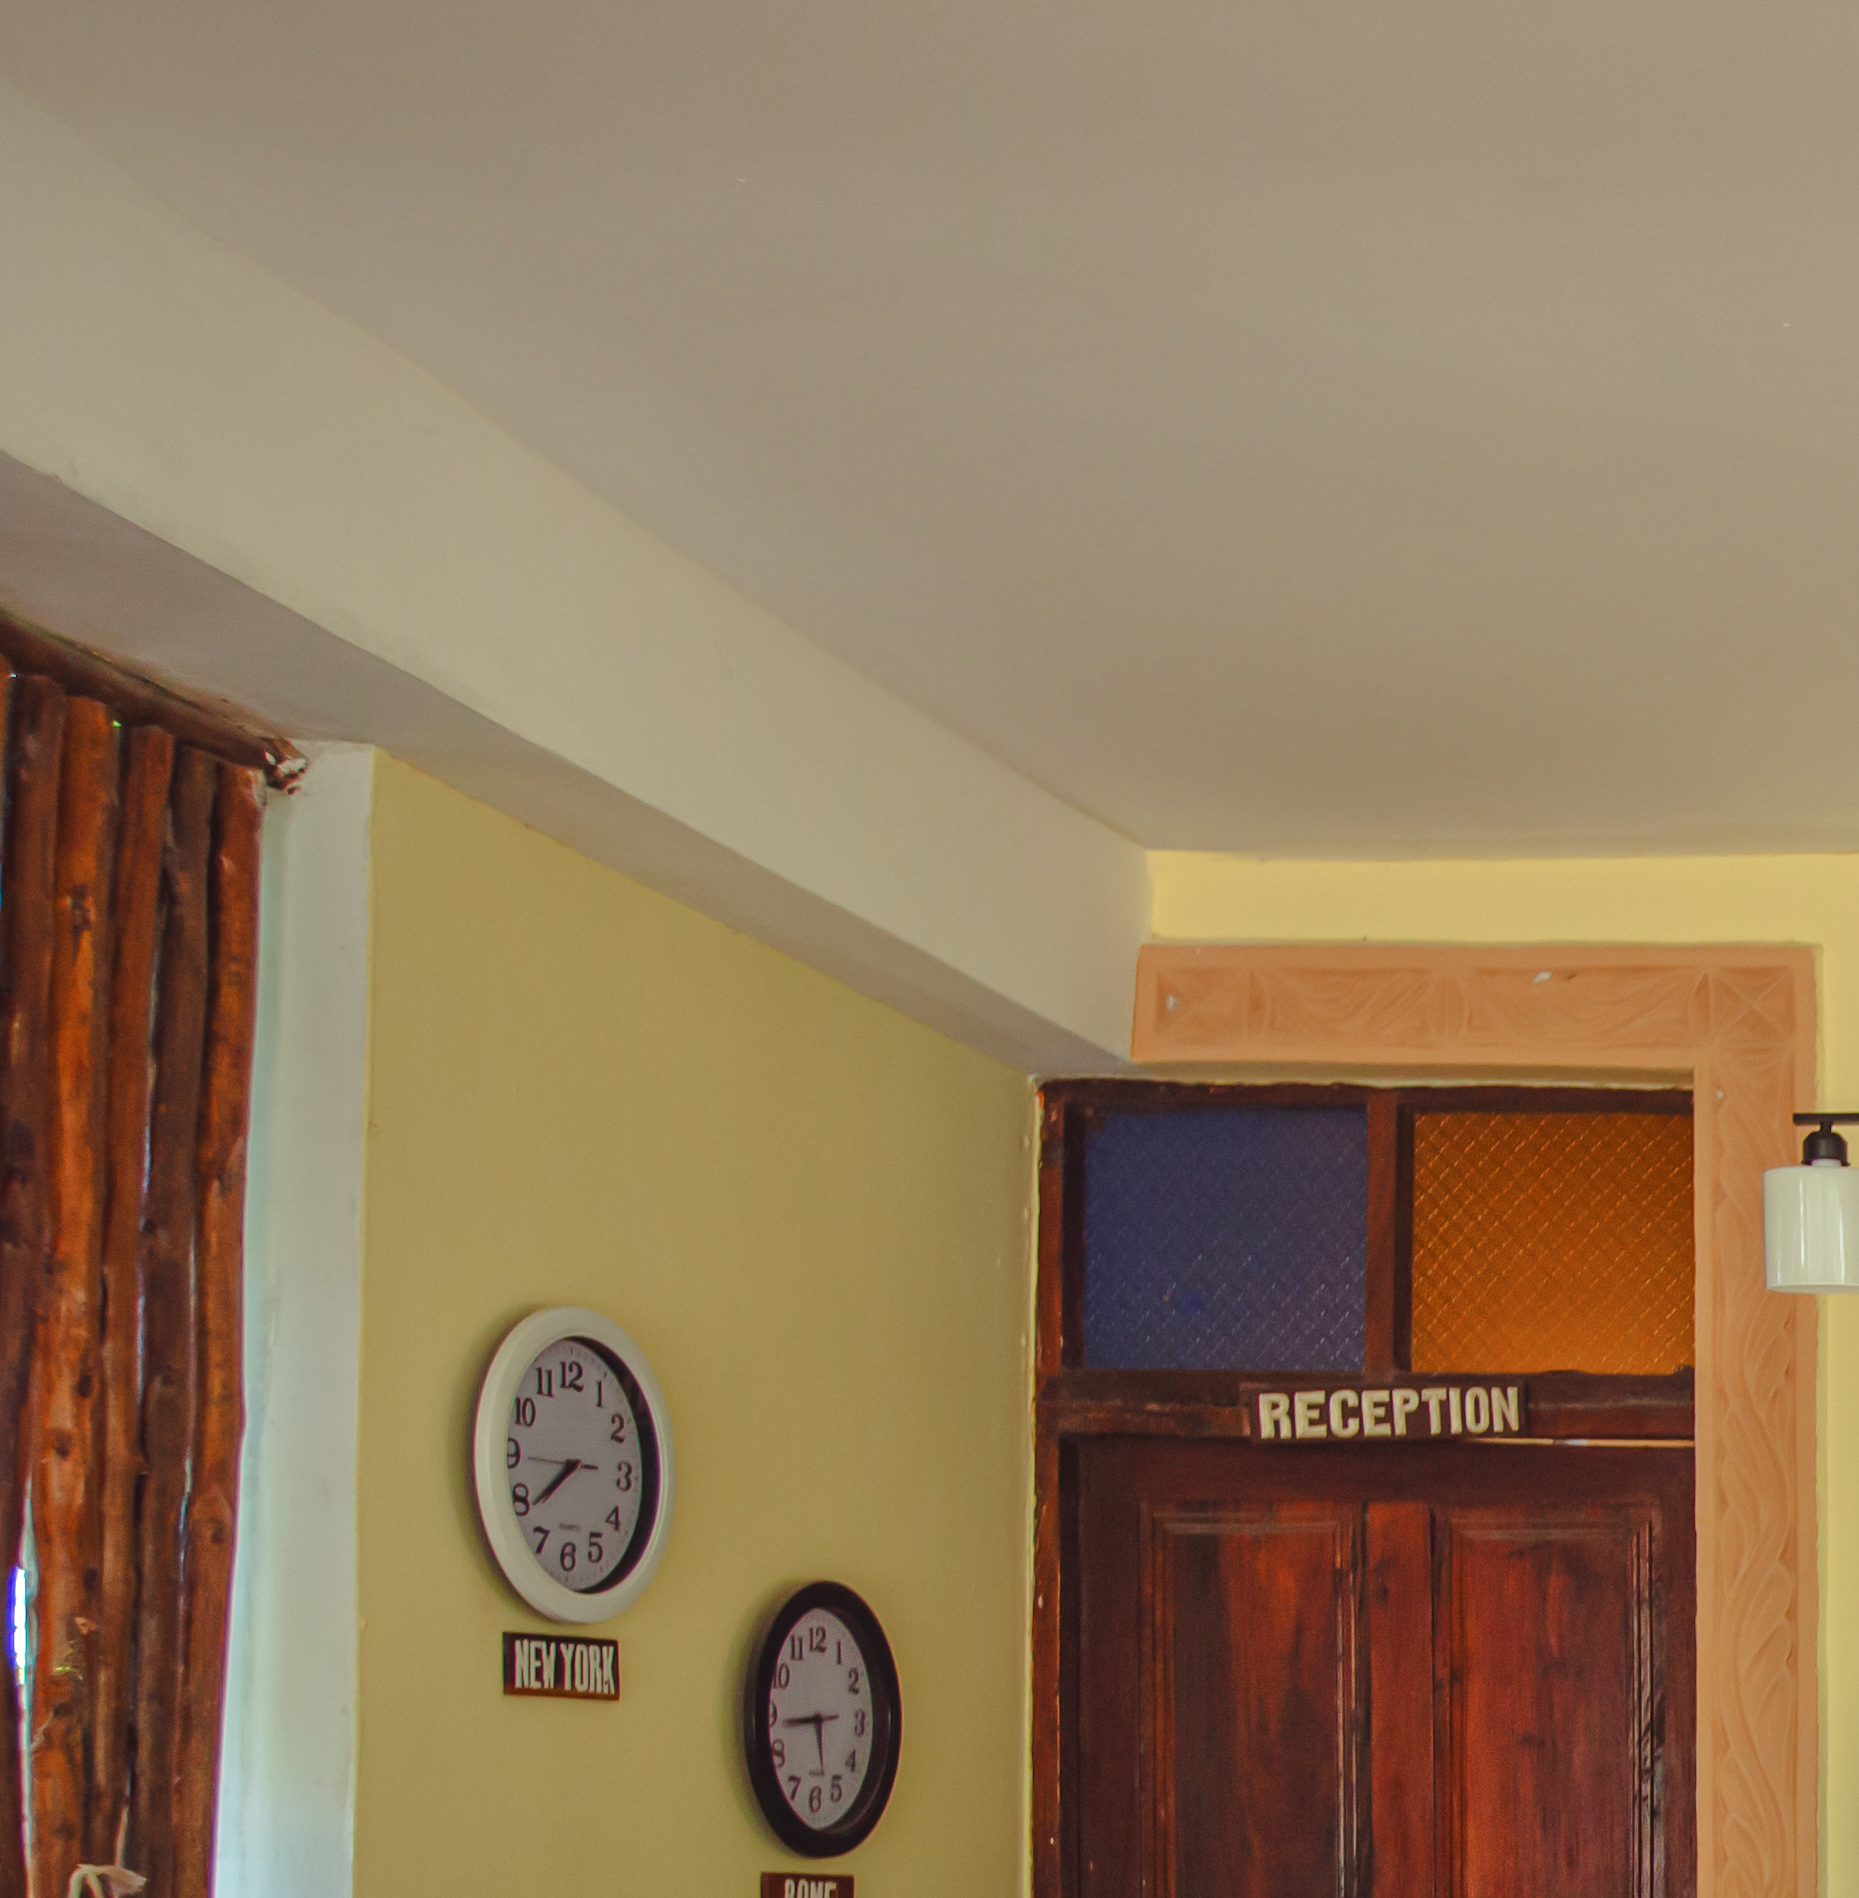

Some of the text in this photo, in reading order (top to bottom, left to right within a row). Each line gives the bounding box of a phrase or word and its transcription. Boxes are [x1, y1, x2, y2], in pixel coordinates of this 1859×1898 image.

[536, 1367, 554, 1398] 11
[560, 1361, 583, 1392] 12
[596, 1381, 603, 1408] 1
[515, 1397, 535, 1427] 10
[1258, 1386, 1519, 1440] RECEPTION
[610, 1413, 625, 1443] 2
[507, 1438, 520, 1469] 9
[616, 1461, 632, 1491] 3
[513, 1483, 530, 1516] 8
[606, 1506, 620, 1530] 4
[533, 1527, 550, 1554] 7
[588, 1532, 603, 1563] 5
[560, 1542, 576, 1571] 6
[790, 1634, 803, 1661] 11
[808, 1627, 826, 1653] 12
[836, 1641, 842, 1665] 1
[514, 1639, 615, 1695] NEW YORK
[772, 1663, 790, 1689] 10
[849, 1668, 860, 1695] 2
[854, 1709, 866, 1737] 3
[772, 1739, 785, 1768] 8
[846, 1750, 856, 1772] 4
[788, 1776, 801, 1800] 7
[809, 1786, 821, 1813] 6
[831, 1776, 843, 1803] 5
